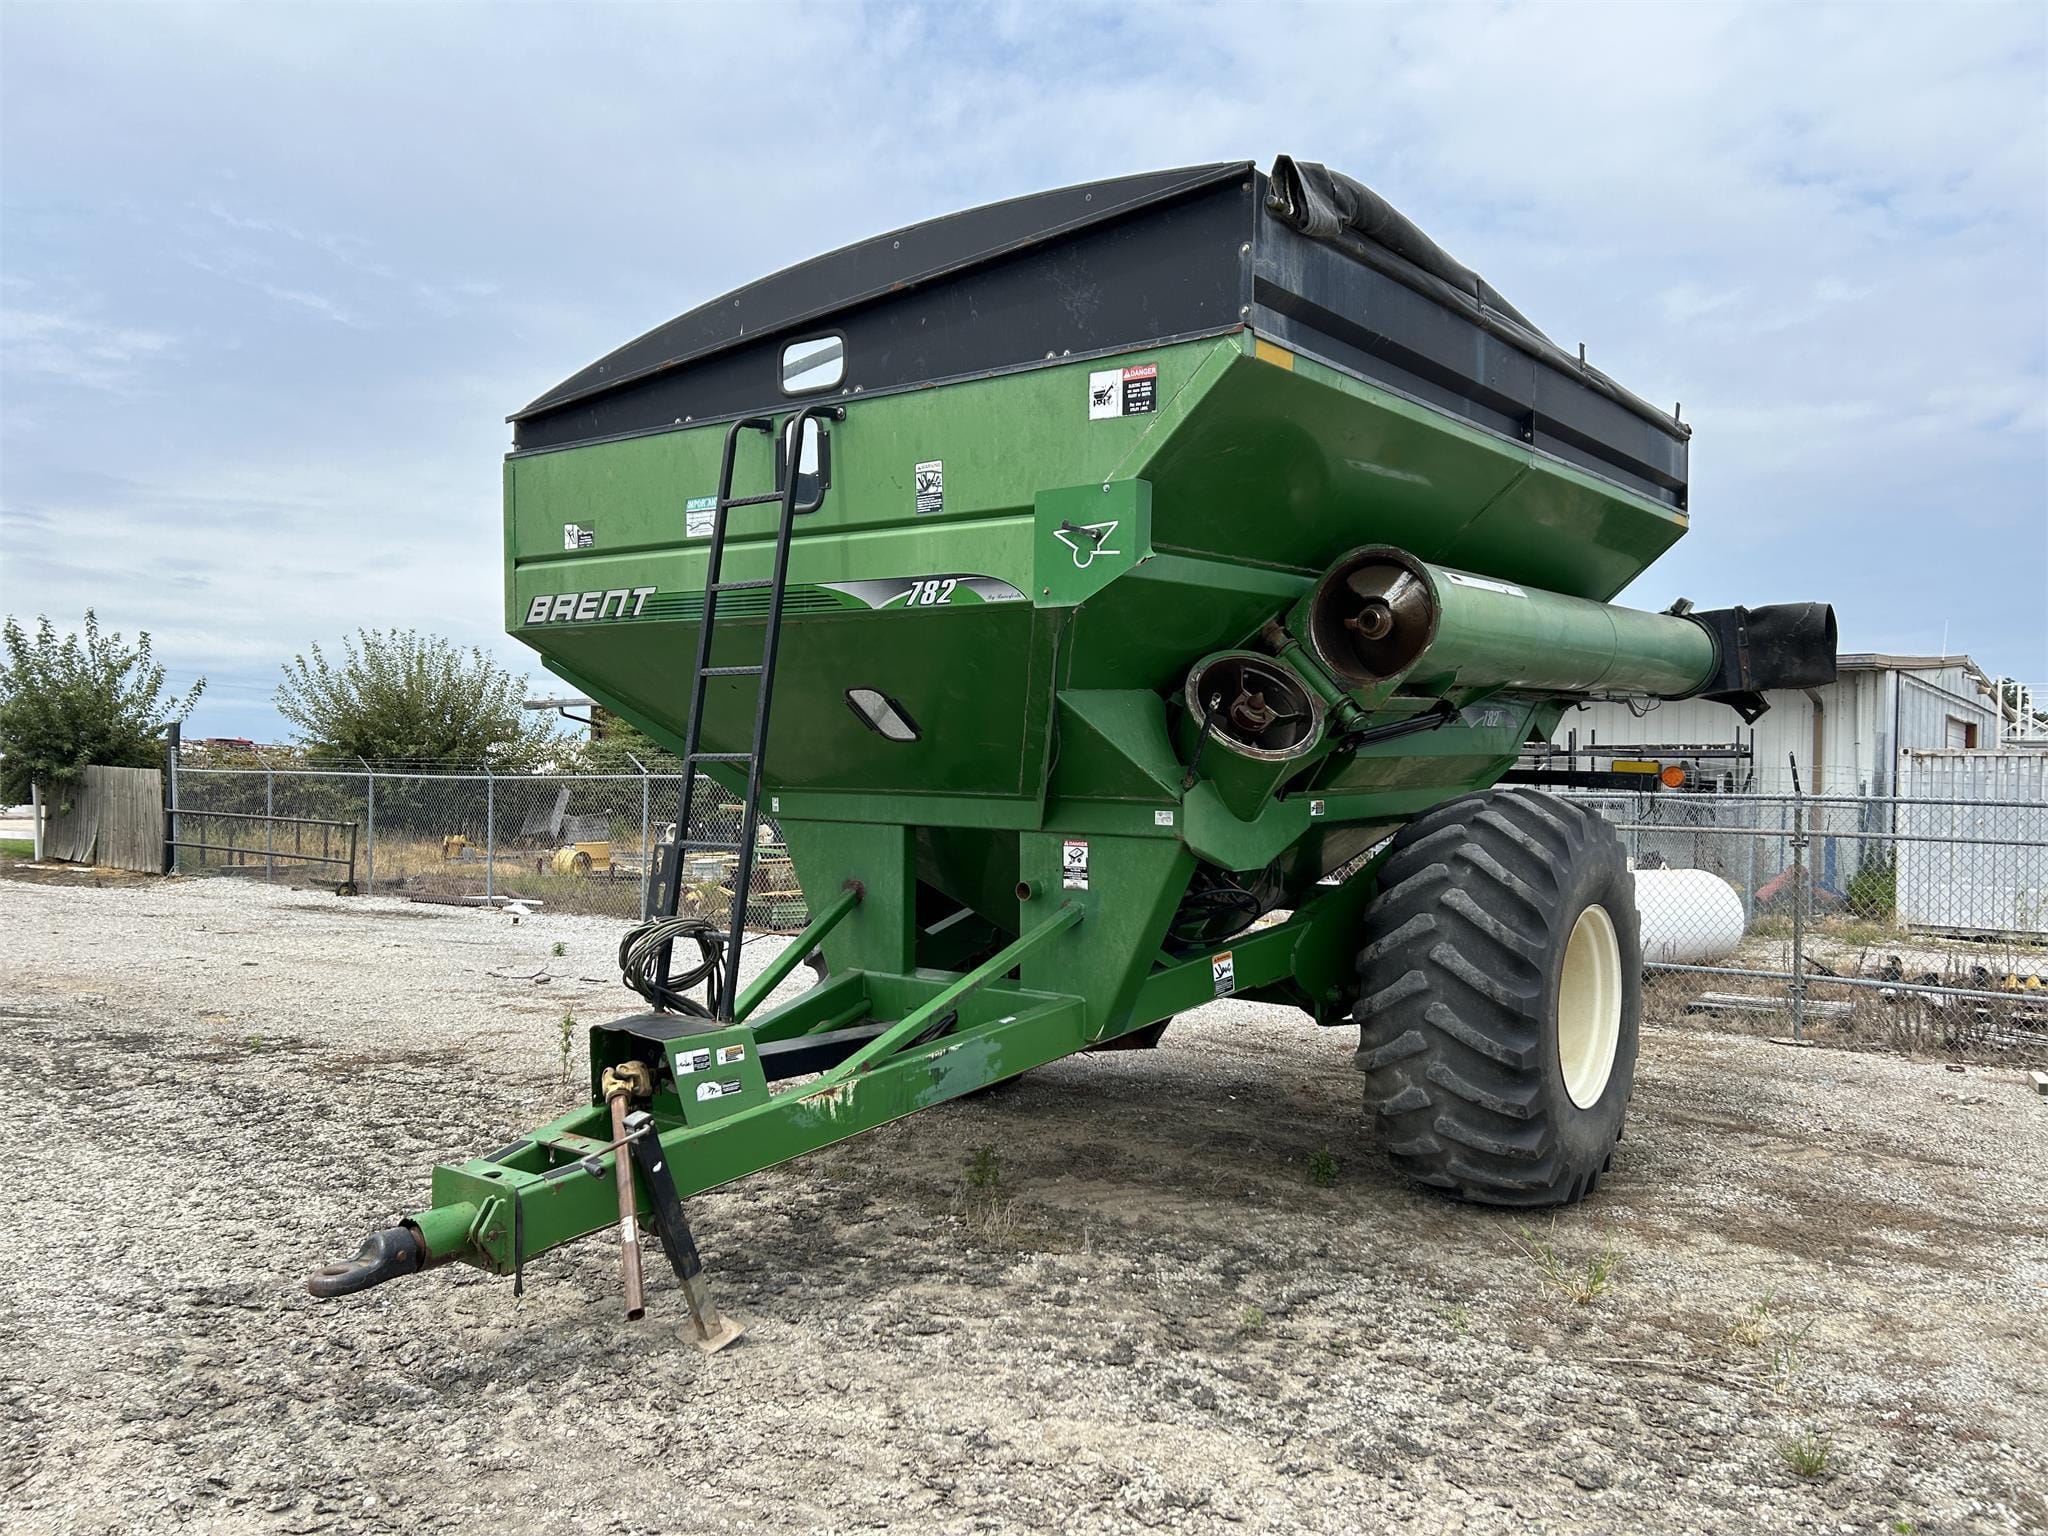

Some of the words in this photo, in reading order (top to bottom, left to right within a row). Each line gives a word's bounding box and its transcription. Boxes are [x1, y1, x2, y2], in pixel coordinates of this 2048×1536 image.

[1130, 367, 1156, 377] DANGER
[906, 579, 958, 606] 782
[526, 586, 657, 623] BRENT
[1481, 710, 1500, 727] 782
